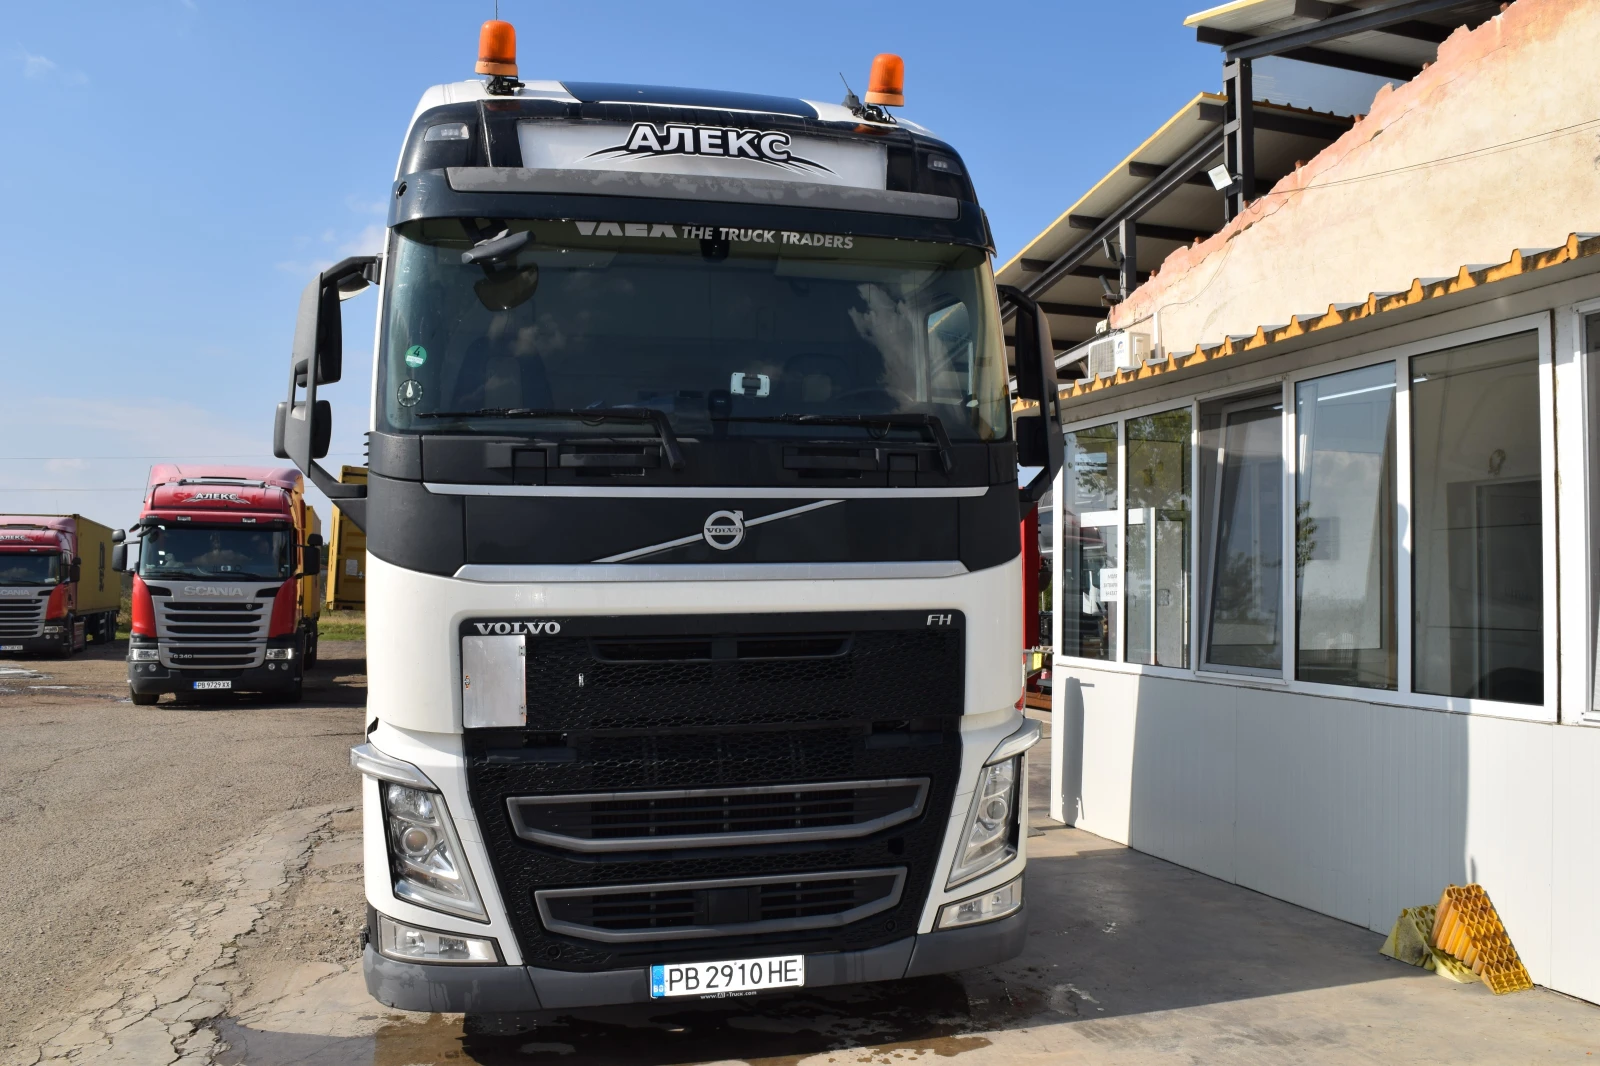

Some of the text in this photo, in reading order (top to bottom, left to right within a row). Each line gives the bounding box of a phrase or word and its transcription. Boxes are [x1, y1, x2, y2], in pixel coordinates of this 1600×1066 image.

[628, 123, 790, 161] АЛЕКС
[681, 226, 713, 240] THE
[719, 228, 775, 243] TRUCK
[781, 231, 854, 249] TRADERS
[413, 346, 421, 357] 4
[183, 585, 244, 596] SCANIA
[926, 614, 952, 626] FH
[473, 622, 561, 635] VOLVO
[705, 962, 763, 989] 2910
